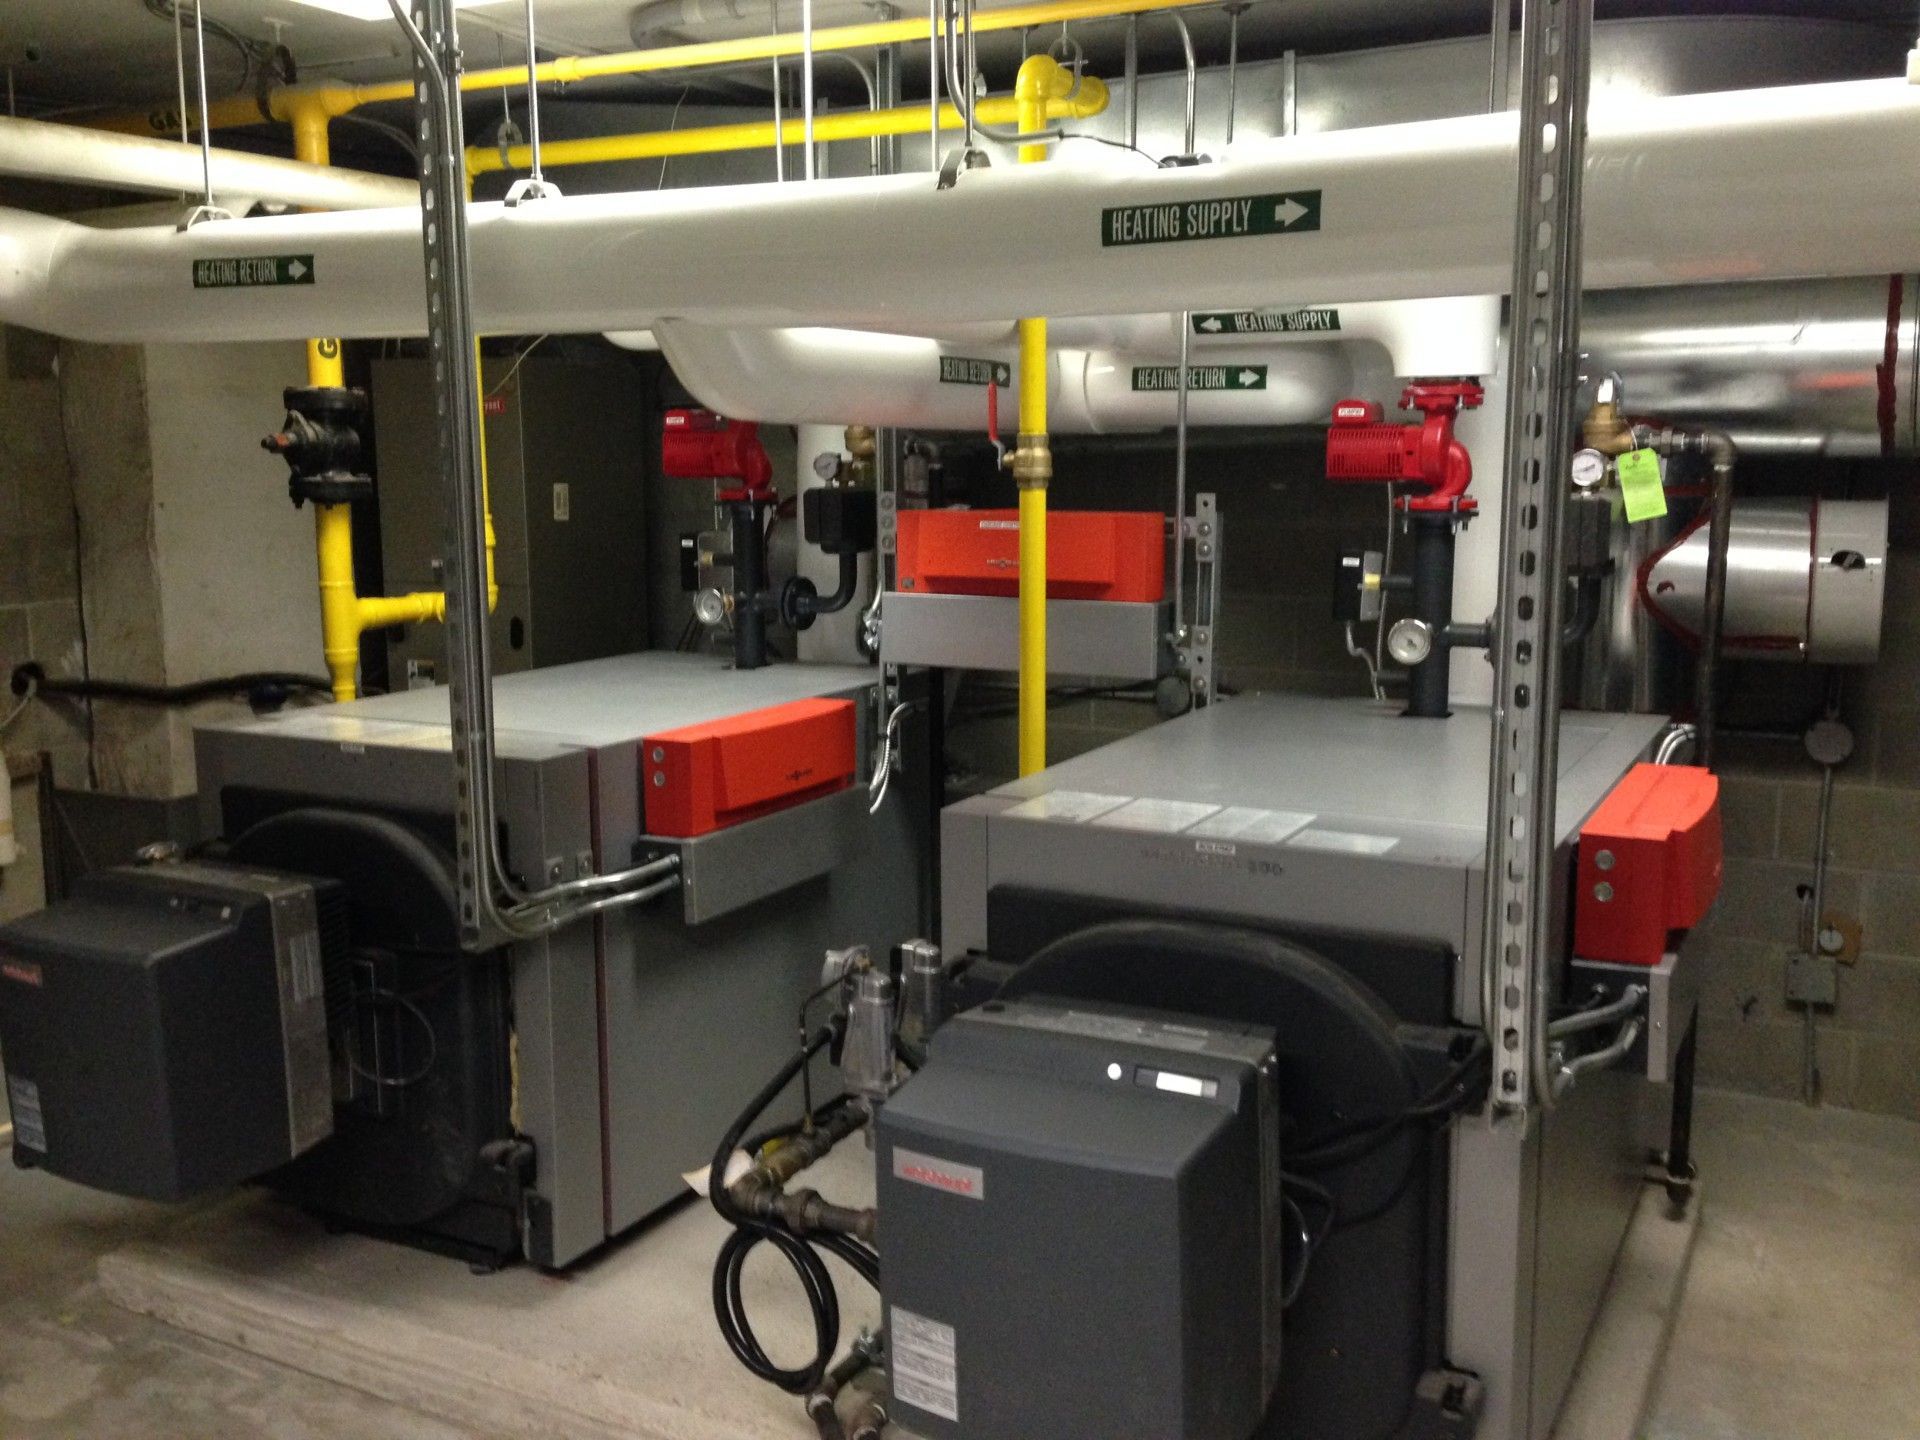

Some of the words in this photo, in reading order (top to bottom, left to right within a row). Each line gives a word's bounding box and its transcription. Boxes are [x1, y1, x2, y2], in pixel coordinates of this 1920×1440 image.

[1111, 205, 1180, 242] HEATING
[1186, 199, 1252, 237] SUPPLY
[198, 259, 237, 285] HEATING
[240, 258, 277, 284] RETURN
[1234, 313, 1283, 332] HEATING
[1287, 311, 1331, 331] SUPPLY
[1186, 367, 1227, 389] RETURN
